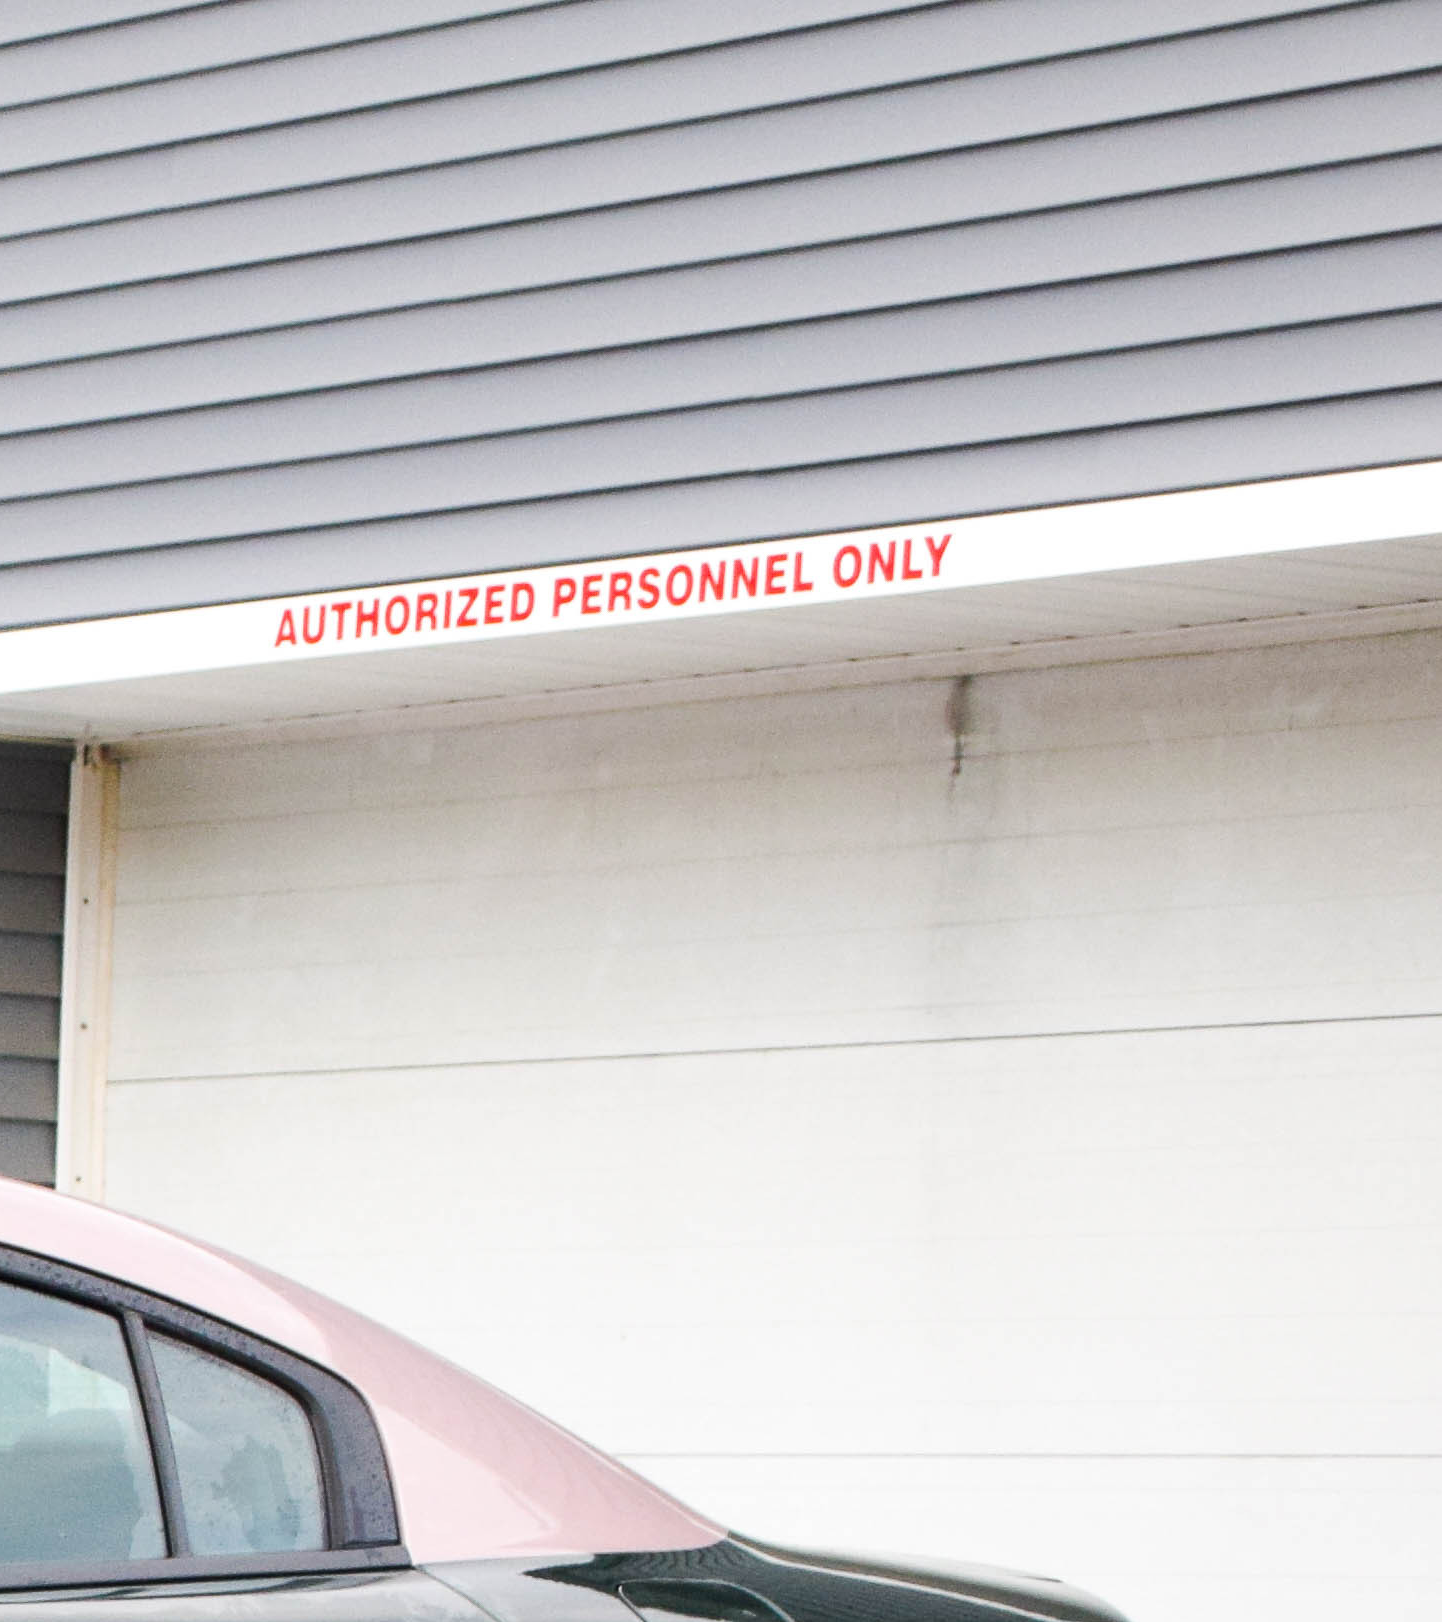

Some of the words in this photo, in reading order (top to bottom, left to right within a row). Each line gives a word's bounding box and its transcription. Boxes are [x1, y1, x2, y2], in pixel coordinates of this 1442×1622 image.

[275, 582, 535, 648] AUTHORIZED
[552, 552, 814, 617] PERSONNEL
[832, 533, 953, 587] ONLY
